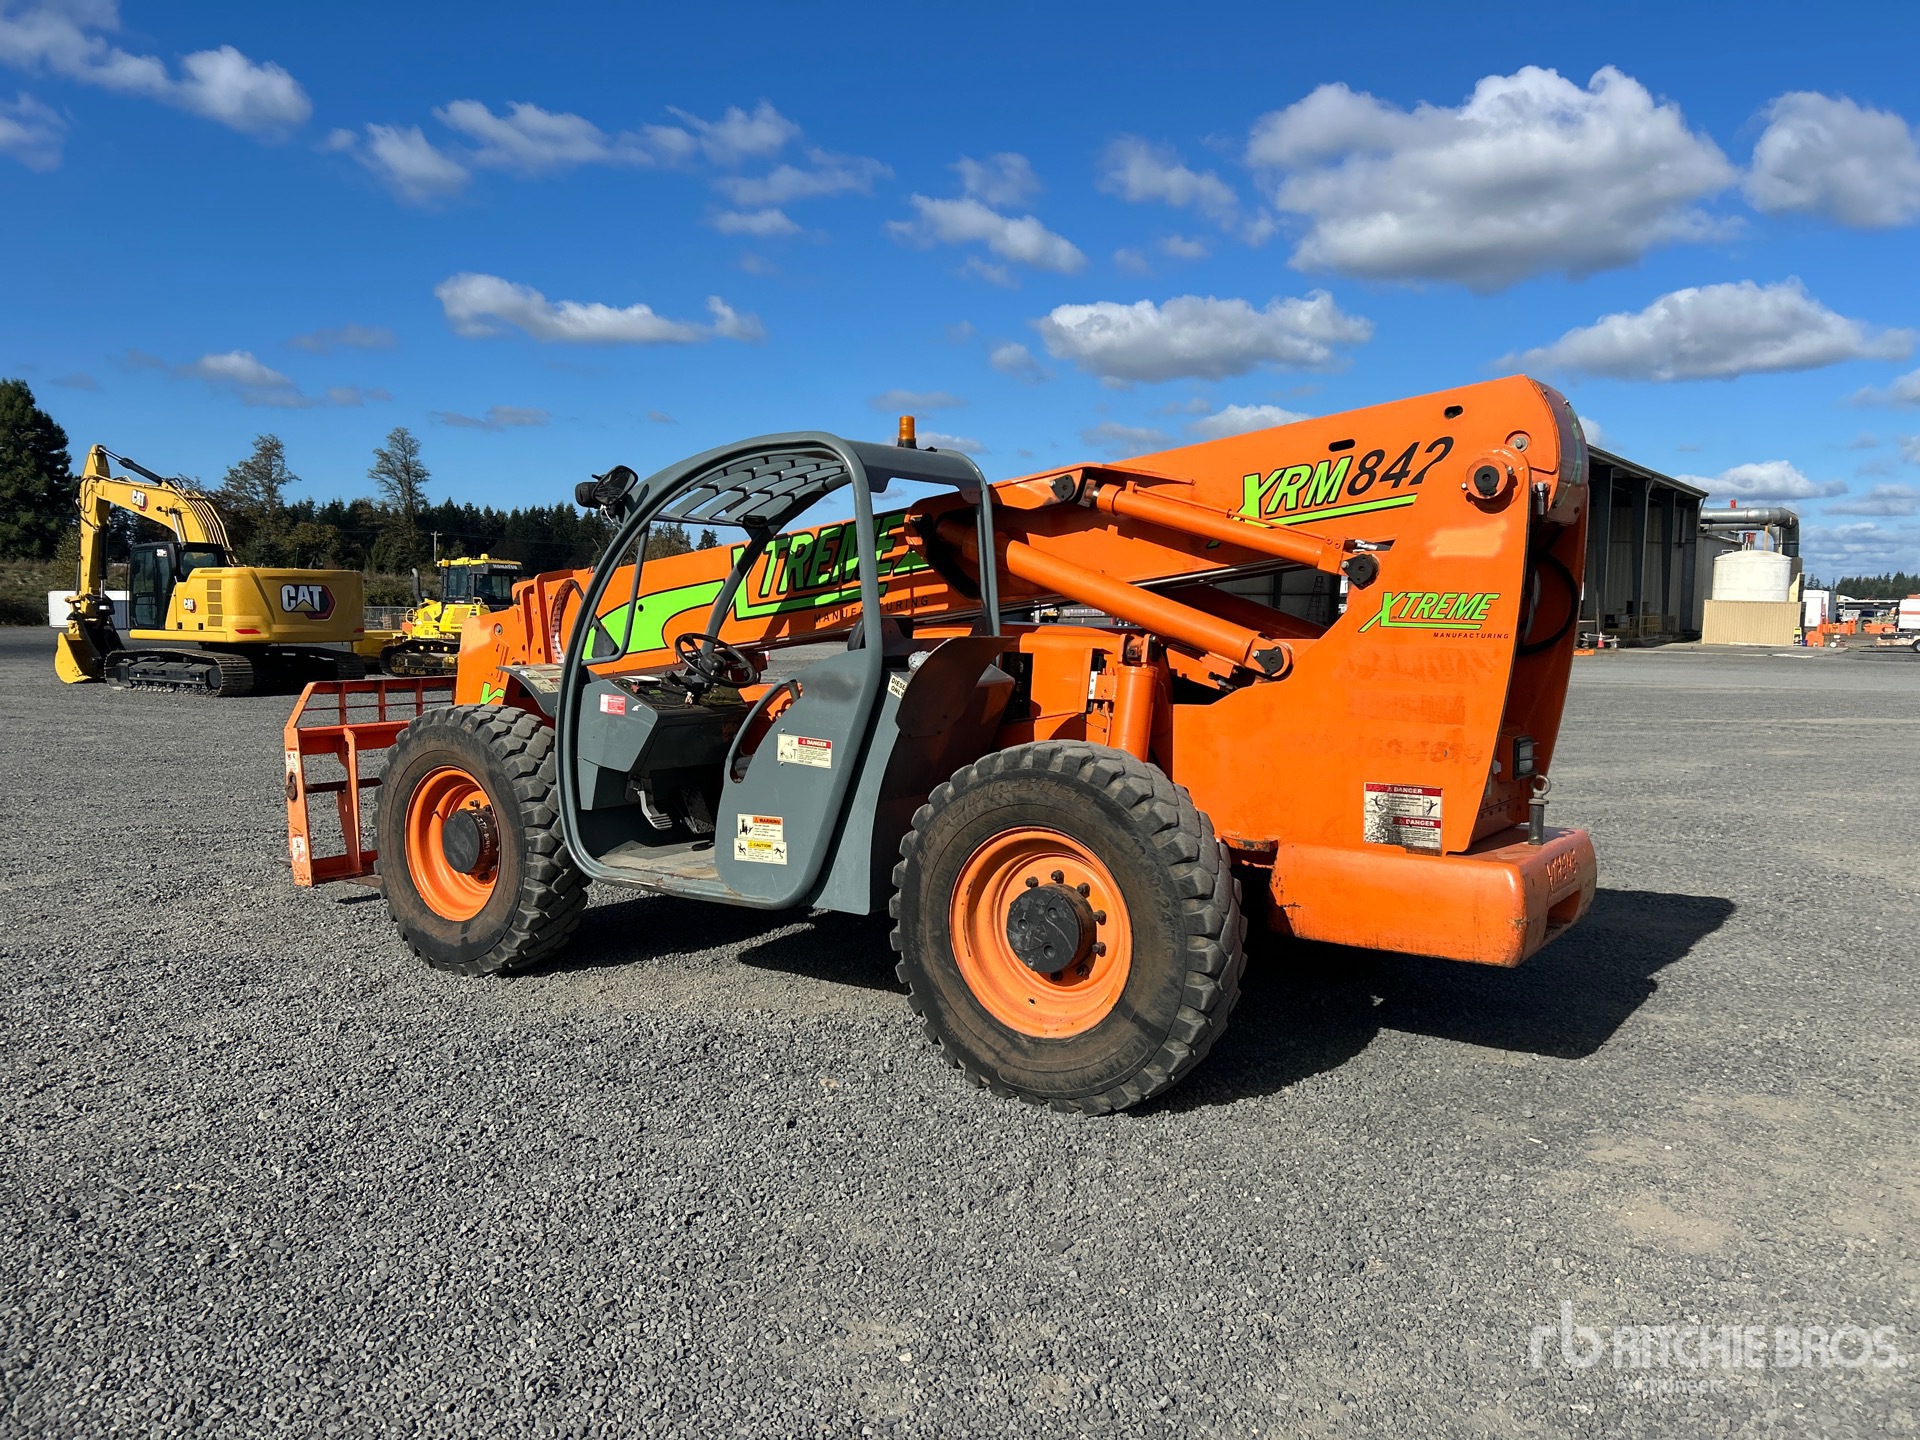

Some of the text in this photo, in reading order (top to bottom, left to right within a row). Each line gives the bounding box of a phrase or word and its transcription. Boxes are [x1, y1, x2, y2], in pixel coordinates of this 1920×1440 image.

[132, 490, 147, 507] CAT
[183, 598, 194, 610] CAT
[281, 585, 323, 612] CAT
[1358, 592, 1500, 633] XTREME
[1433, 632, 1509, 640] MANUFACTURING
[891, 677, 906, 691] DIESE
[806, 739, 827, 747] DANGER
[1393, 786, 1423, 794] DANGER
[1405, 818, 1435, 827] DANGER
